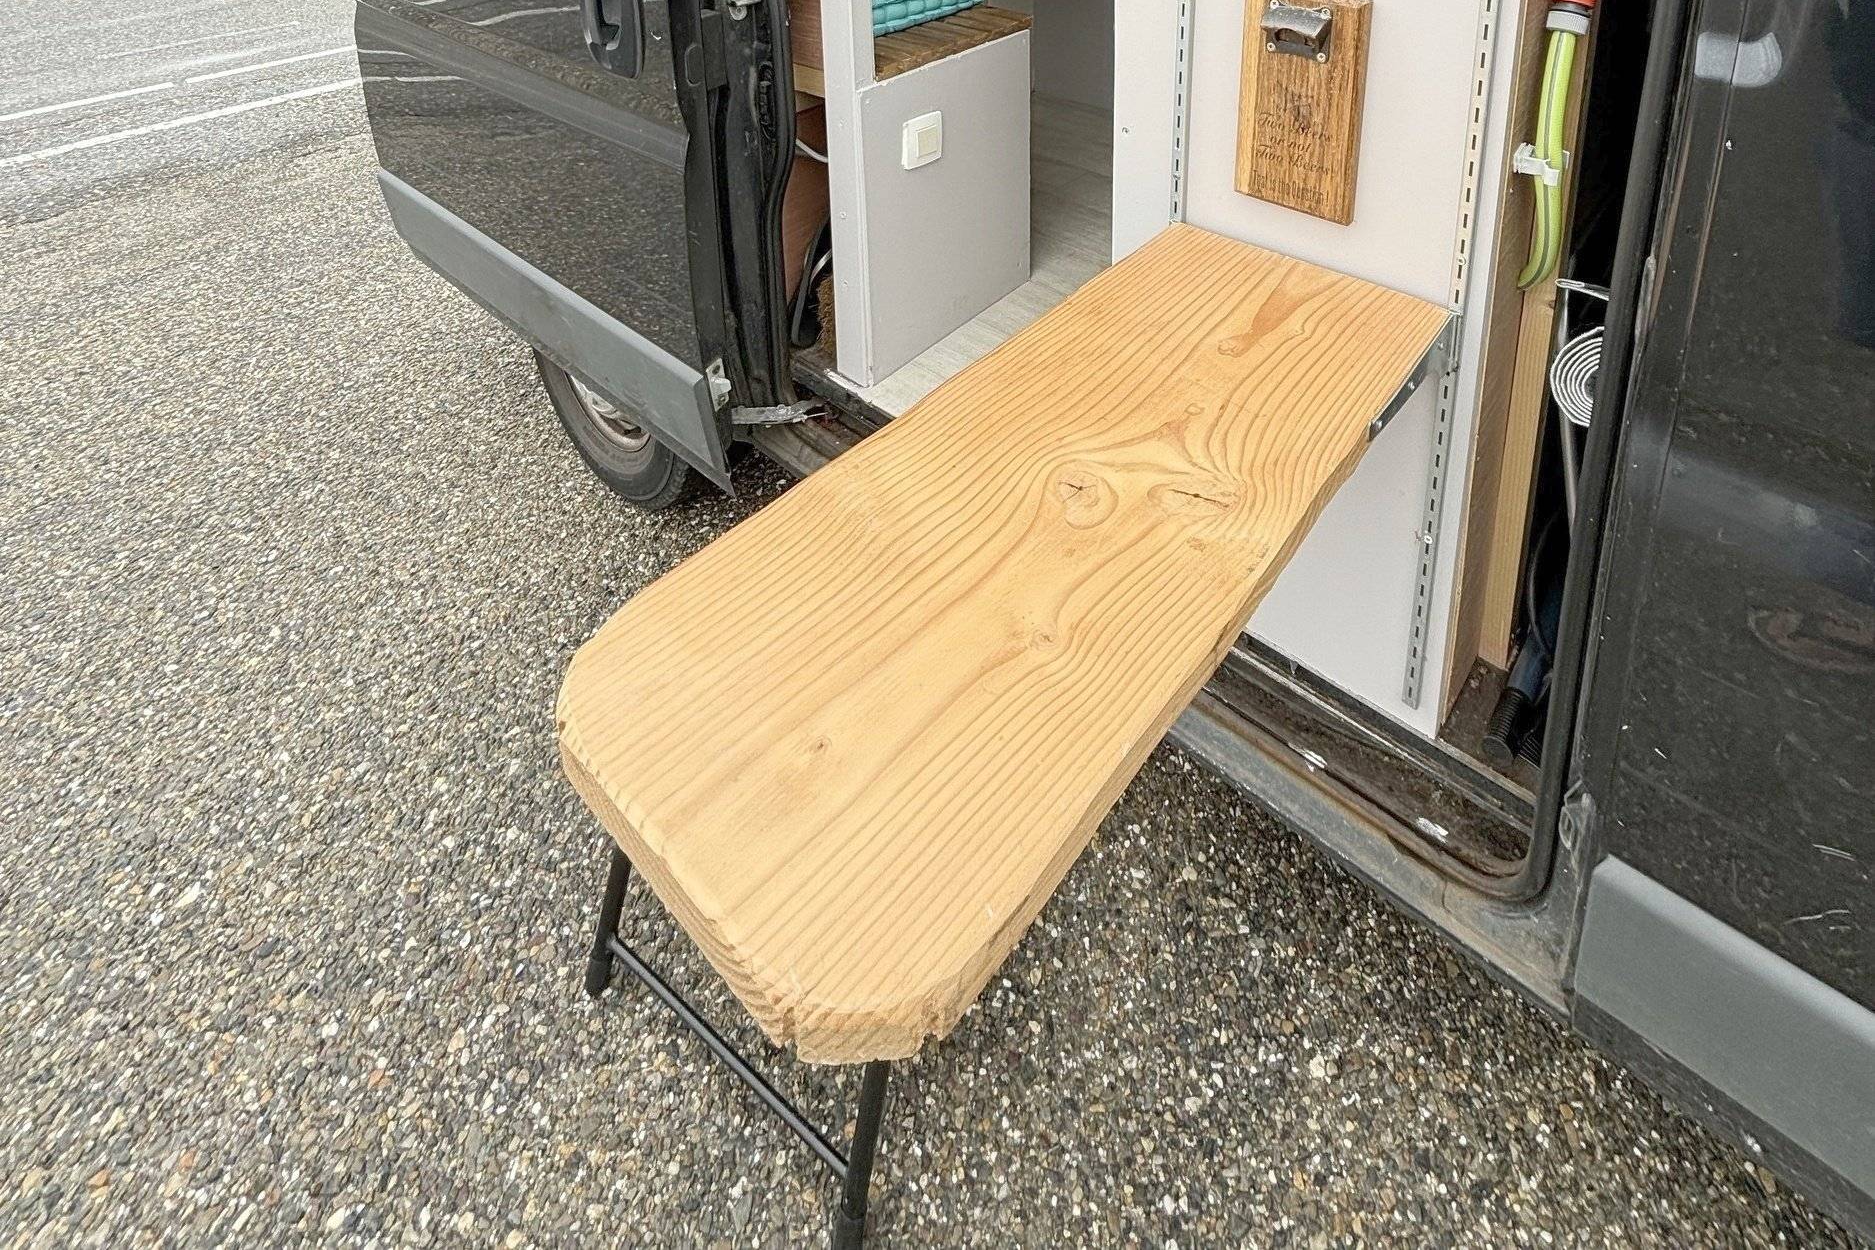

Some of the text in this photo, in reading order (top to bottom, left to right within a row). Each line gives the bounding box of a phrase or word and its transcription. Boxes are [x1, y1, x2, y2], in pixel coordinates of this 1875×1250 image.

[1257, 112, 1285, 130] Two
[1255, 144, 1284, 161] Two
[1270, 135, 1312, 153] or not
